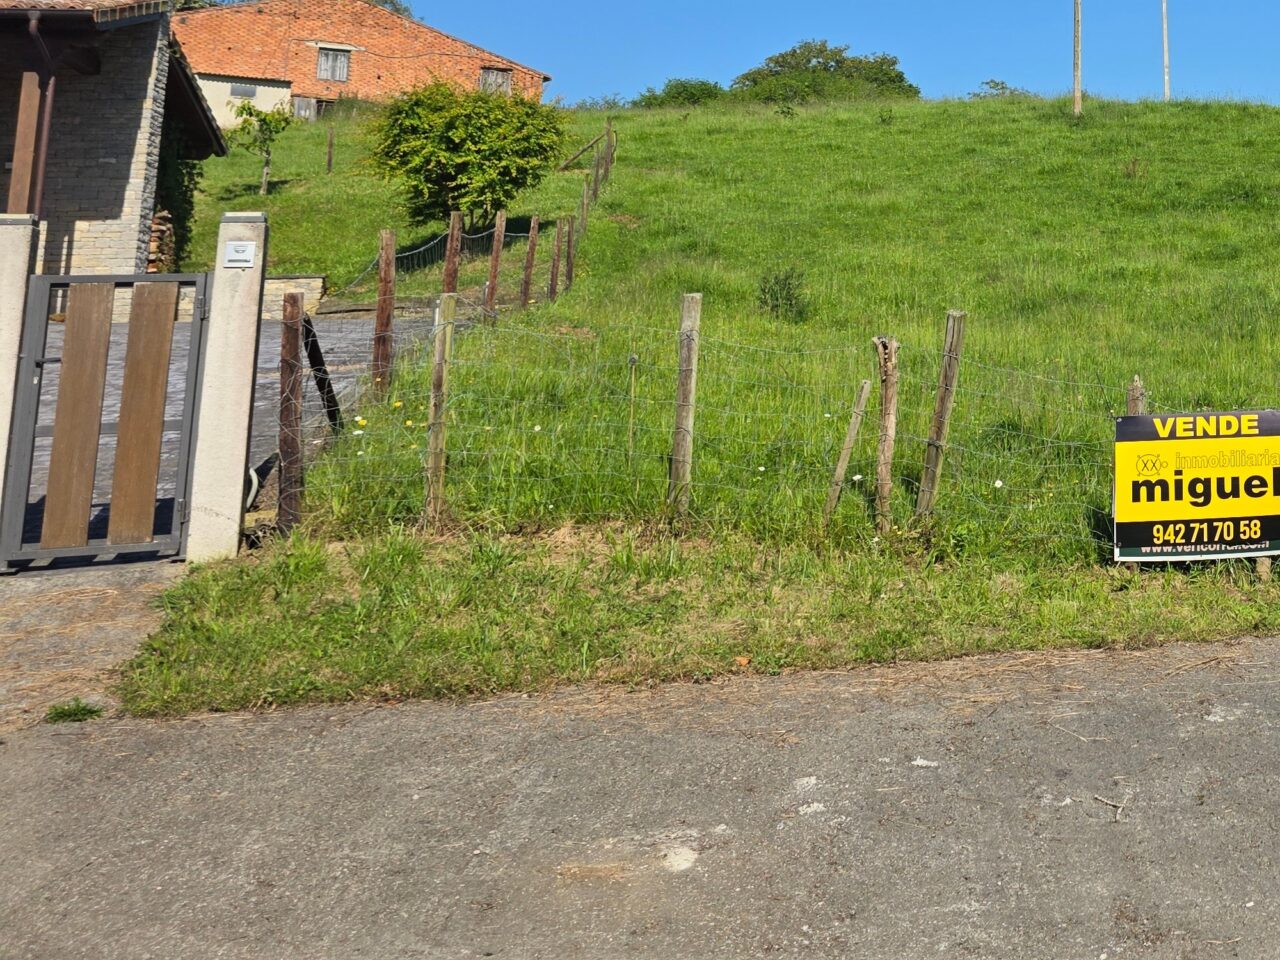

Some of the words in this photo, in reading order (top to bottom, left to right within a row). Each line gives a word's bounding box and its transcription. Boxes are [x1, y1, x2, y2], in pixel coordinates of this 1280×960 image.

[1153, 414, 1260, 438] VENDE
[1175, 449, 1280, 469] inmobiliaria
[1152, 523, 1186, 544] 942
[1190, 522, 1208, 543] 71
[1213, 521, 1234, 541] 70
[1239, 519, 1261, 539] 58
